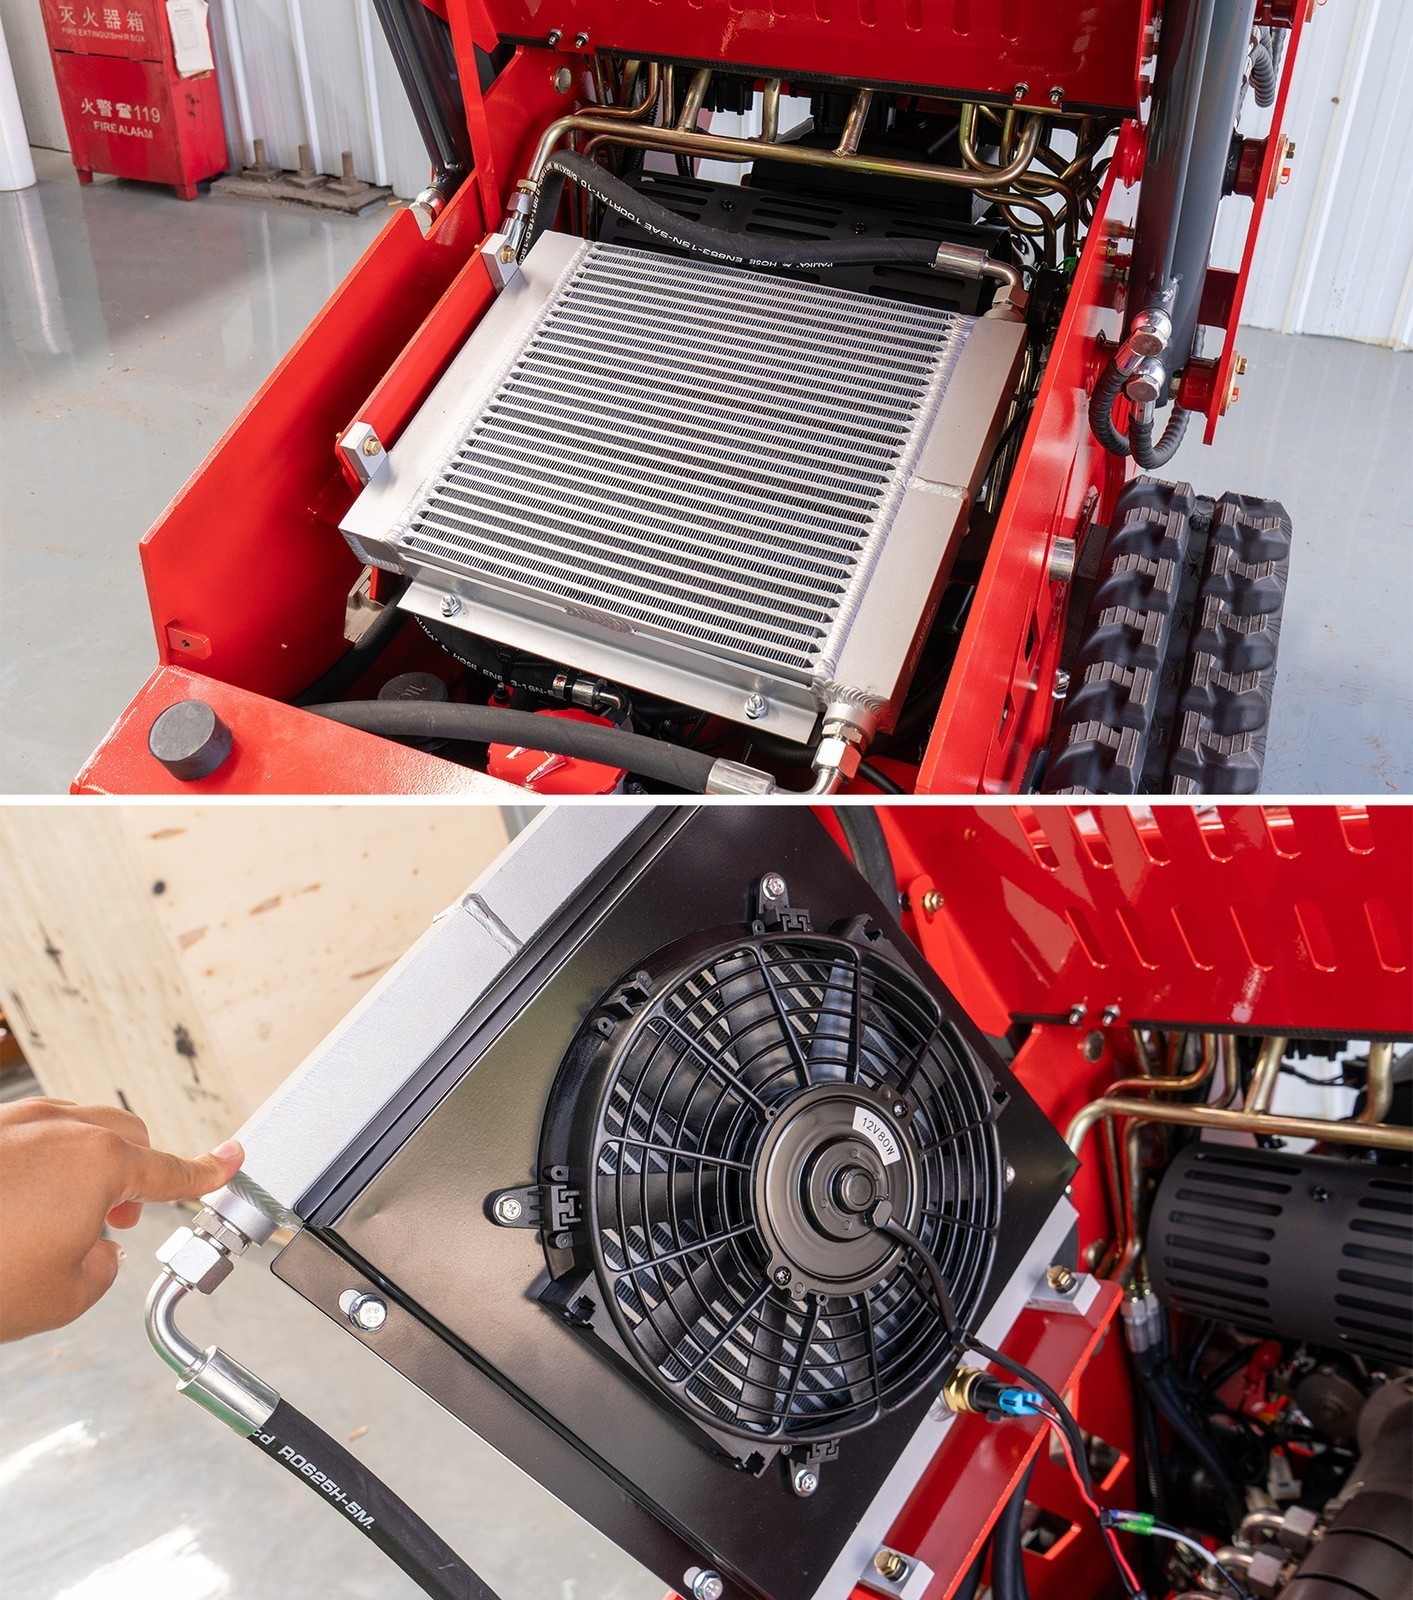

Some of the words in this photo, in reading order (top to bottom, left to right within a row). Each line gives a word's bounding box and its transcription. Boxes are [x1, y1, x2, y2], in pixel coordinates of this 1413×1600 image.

[58, 5, 145, 32] 灭火器箱
[62, 27, 77, 36] FIRE
[78, 28, 130, 41] EXTINGUISHER
[130, 33, 146, 42] BOX
[80, 97, 113, 118] 火警
[133, 104, 161, 124] 119
[93, 120, 118, 134] FIRE
[118, 123, 154, 139] ALARM
